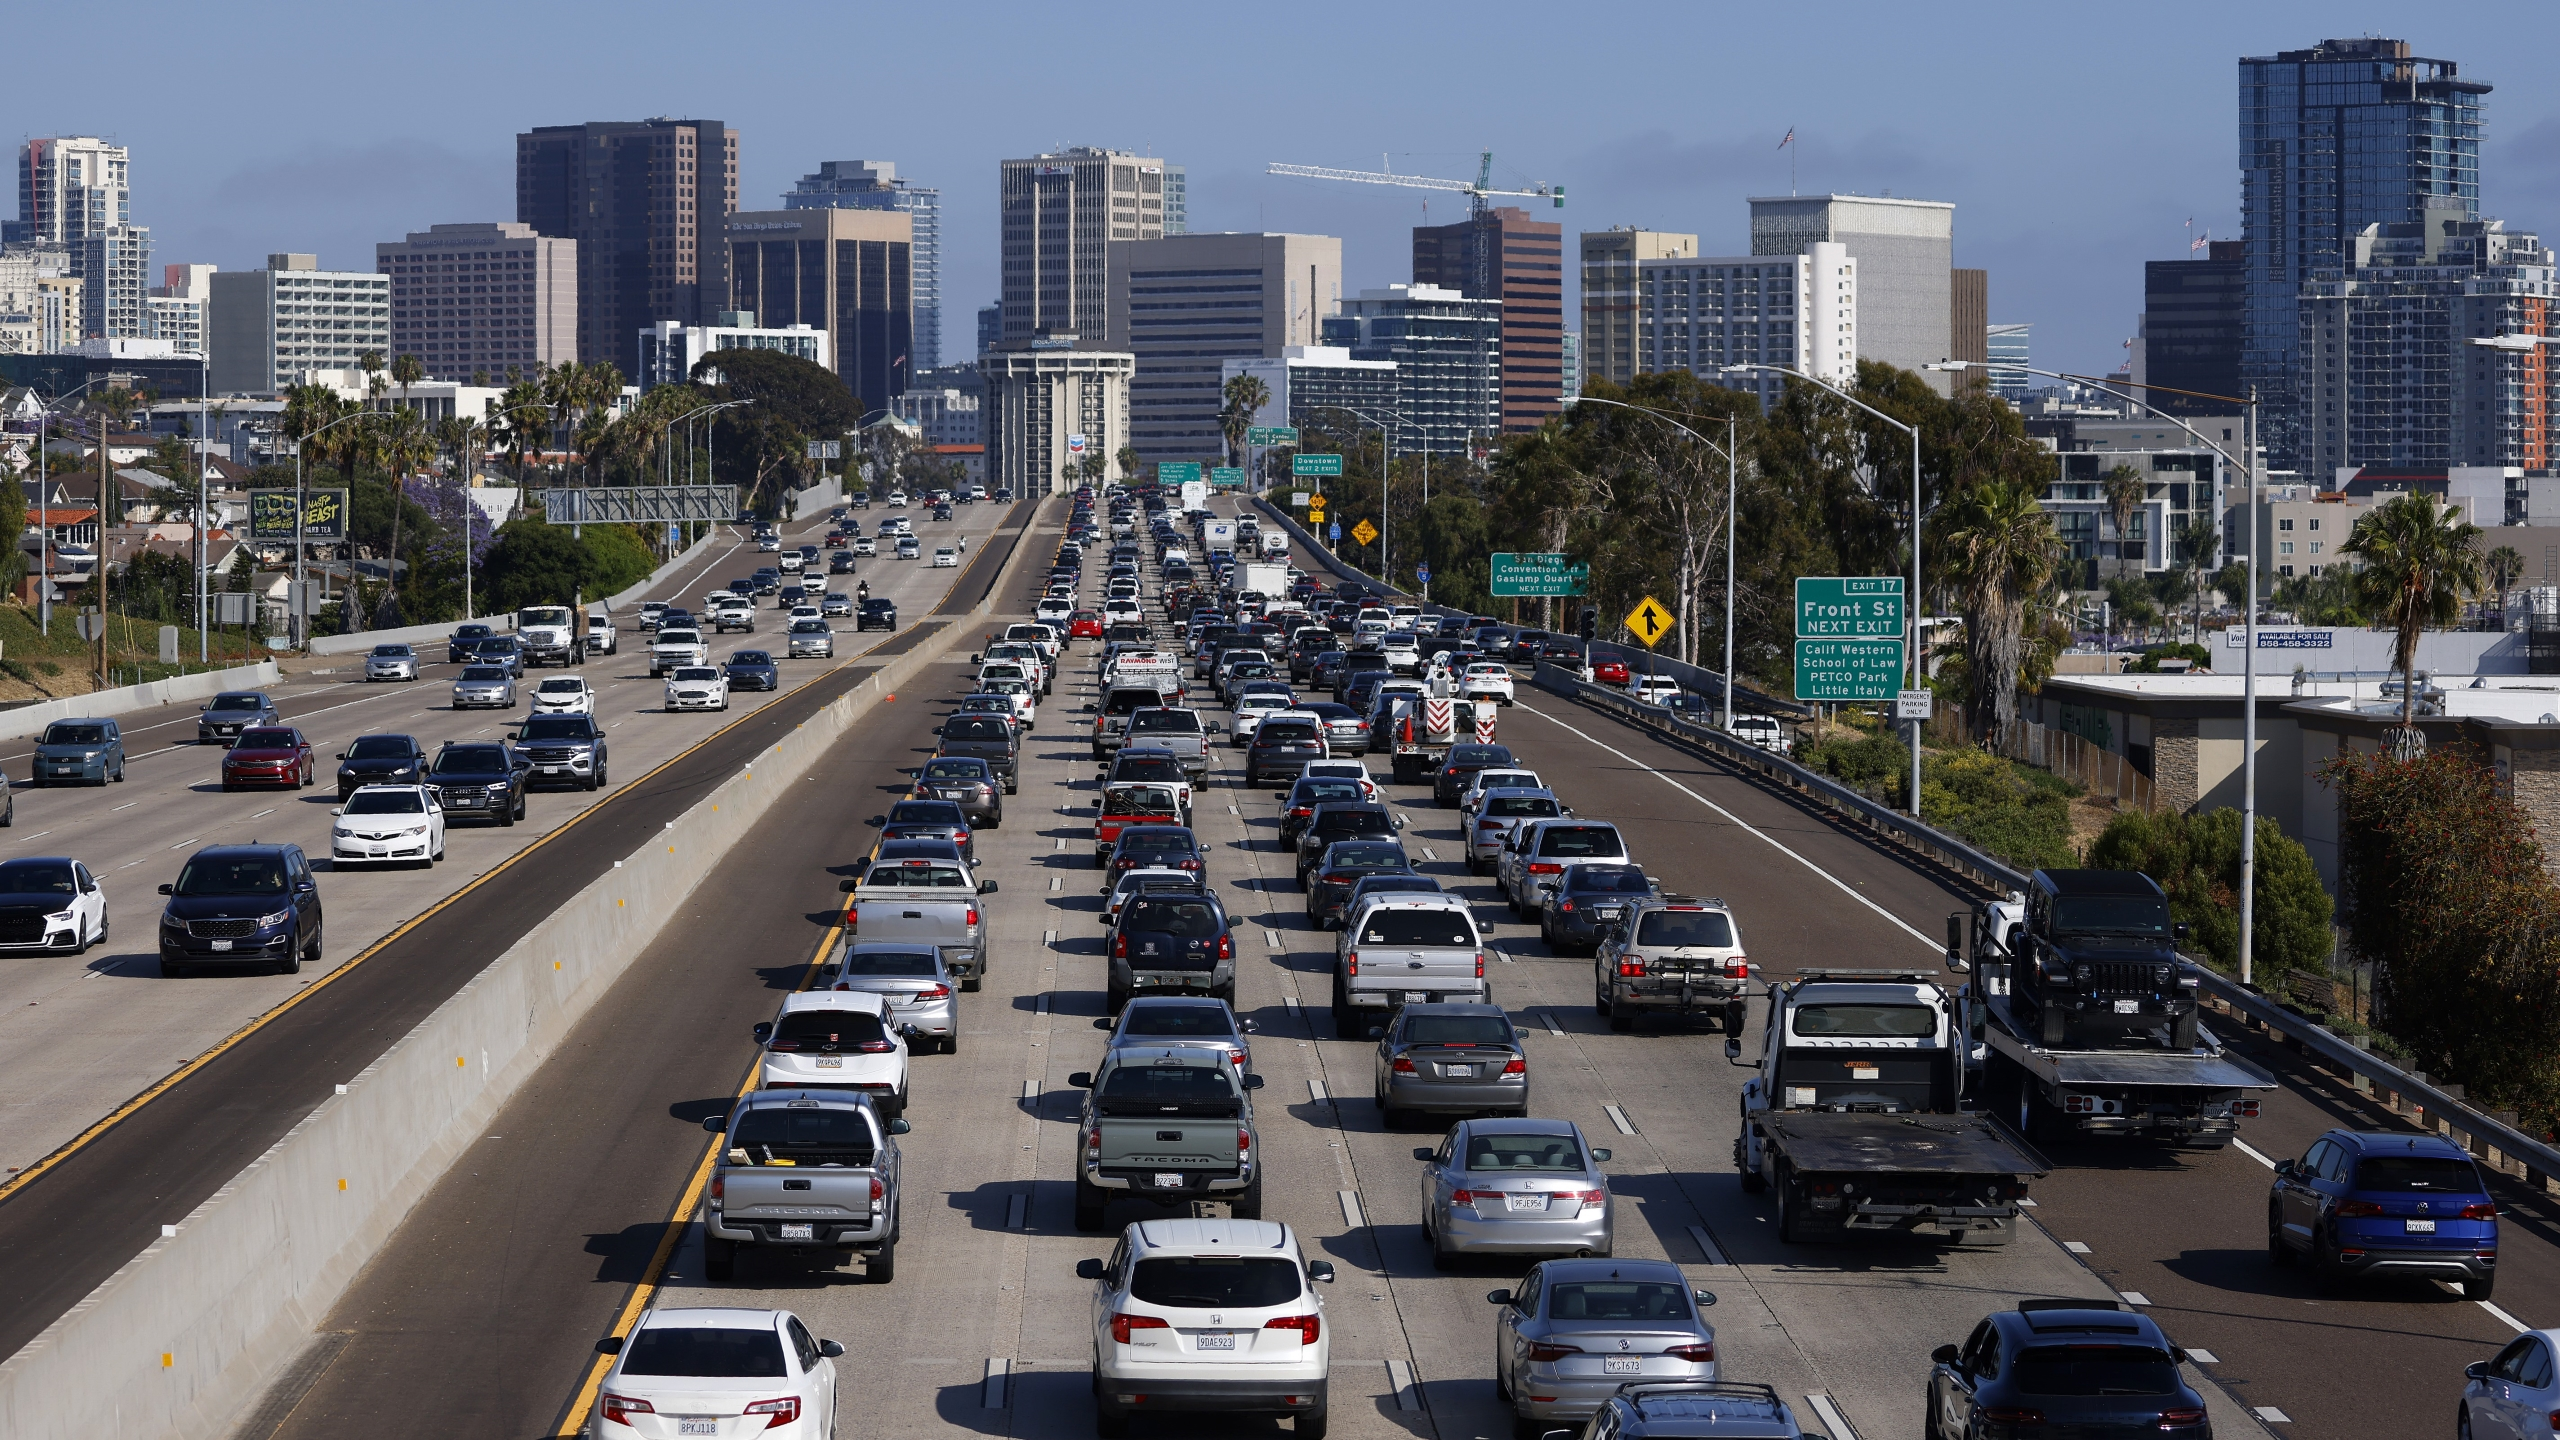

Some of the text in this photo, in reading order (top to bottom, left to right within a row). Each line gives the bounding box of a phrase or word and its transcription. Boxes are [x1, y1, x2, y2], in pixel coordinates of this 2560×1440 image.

[743, 222, 753, 230] San
[307, 494, 332, 509] NASTY
[1500, 564, 1558, 573] Convention
[1496, 574, 1540, 584] Gaslamp
[1852, 580, 1897, 592] EXIT 17
[1804, 601, 1895, 617] Front St
[1807, 620, 1893, 633] NEXT EXIT
[1805, 644, 1895, 655] Calif Western
[1803, 657, 1897, 668] School of Law
[1810, 671, 1888, 682] PETCO Park
[1812, 685, 1886, 698] Little Italy
[1130, 1156, 1210, 1164] TACOMA
[754, 1207, 840, 1215] TACOMA
[1200, 1338, 1233, 1347] 9DAE923
[681, 1423, 716, 1433] 8PKJ118
